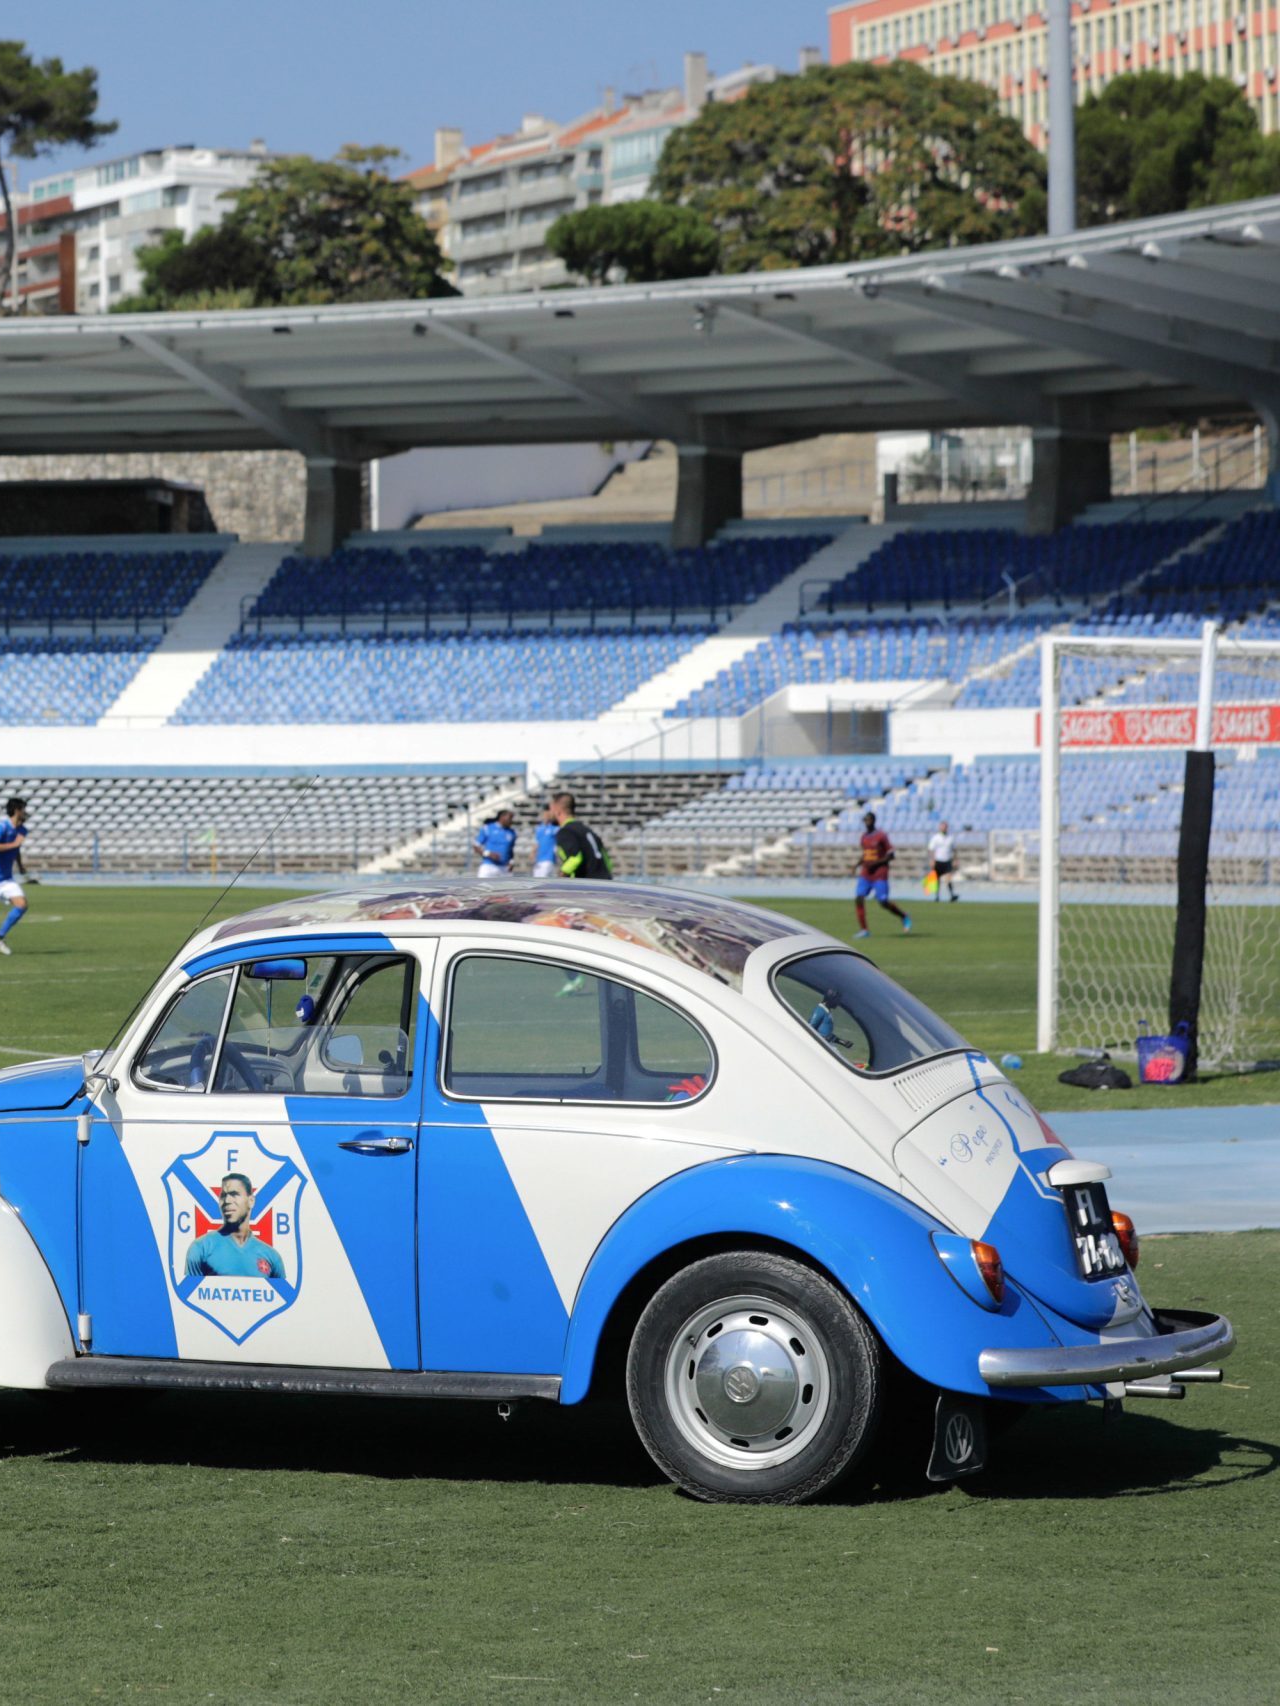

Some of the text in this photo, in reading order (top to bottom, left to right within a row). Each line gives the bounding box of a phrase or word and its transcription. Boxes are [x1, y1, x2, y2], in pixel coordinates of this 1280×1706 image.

[1142, 709, 1192, 742] SAGRES
[1219, 707, 1269, 739] SAGRES
[227, 1150, 239, 1171] F
[177, 1211, 291, 1235] C B
[197, 1287, 275, 1303] MATATEU
